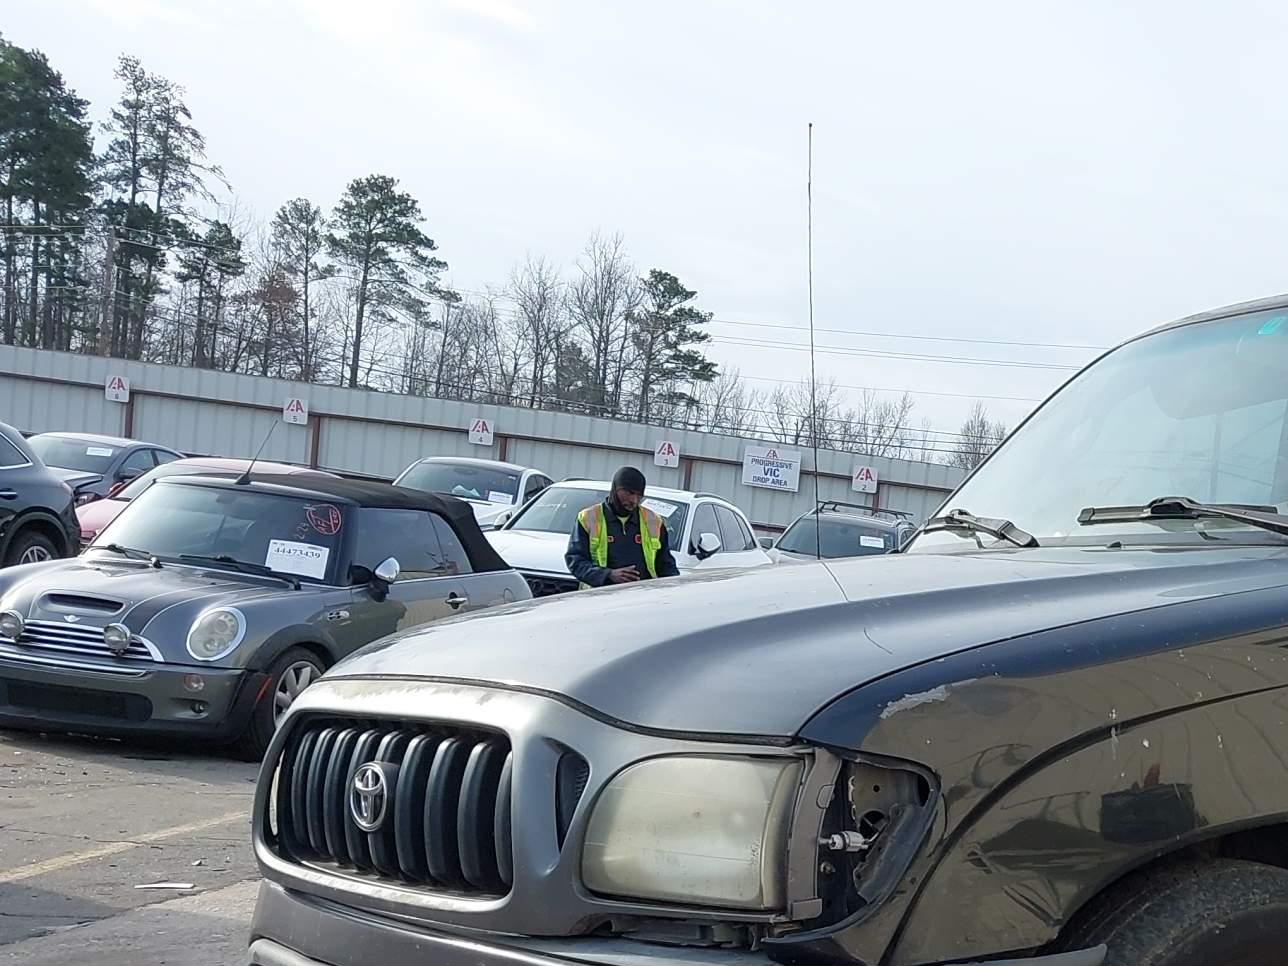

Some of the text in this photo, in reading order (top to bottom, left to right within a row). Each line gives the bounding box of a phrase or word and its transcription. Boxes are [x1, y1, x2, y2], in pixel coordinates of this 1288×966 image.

[751, 458, 793, 470] PROGRESSIVE
[763, 466, 780, 478] VIC
[752, 475, 788, 487] DROP AREA
[273, 546, 321, 559] 44473439
